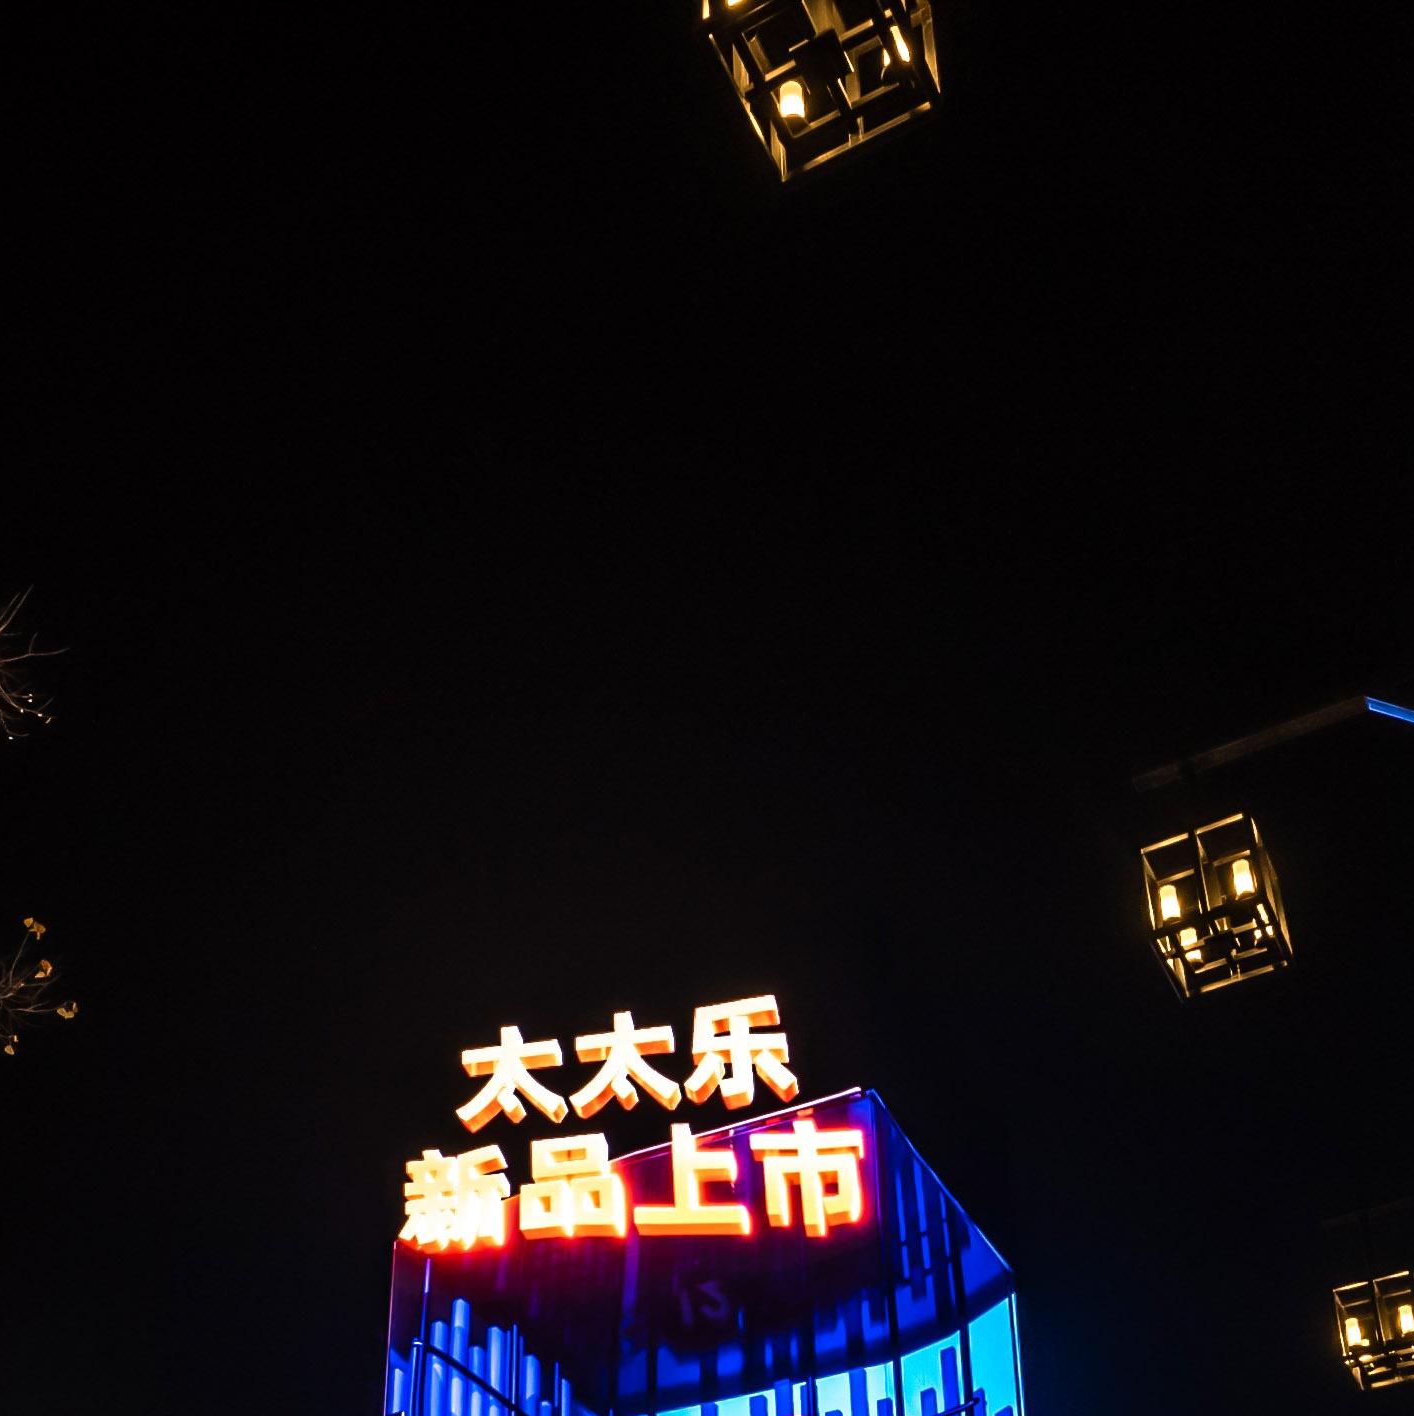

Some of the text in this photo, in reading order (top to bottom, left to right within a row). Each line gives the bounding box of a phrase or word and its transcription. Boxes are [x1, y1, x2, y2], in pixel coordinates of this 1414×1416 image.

[455, 994, 800, 1133] 太太乐
[398, 1118, 865, 1254] 新品上市
